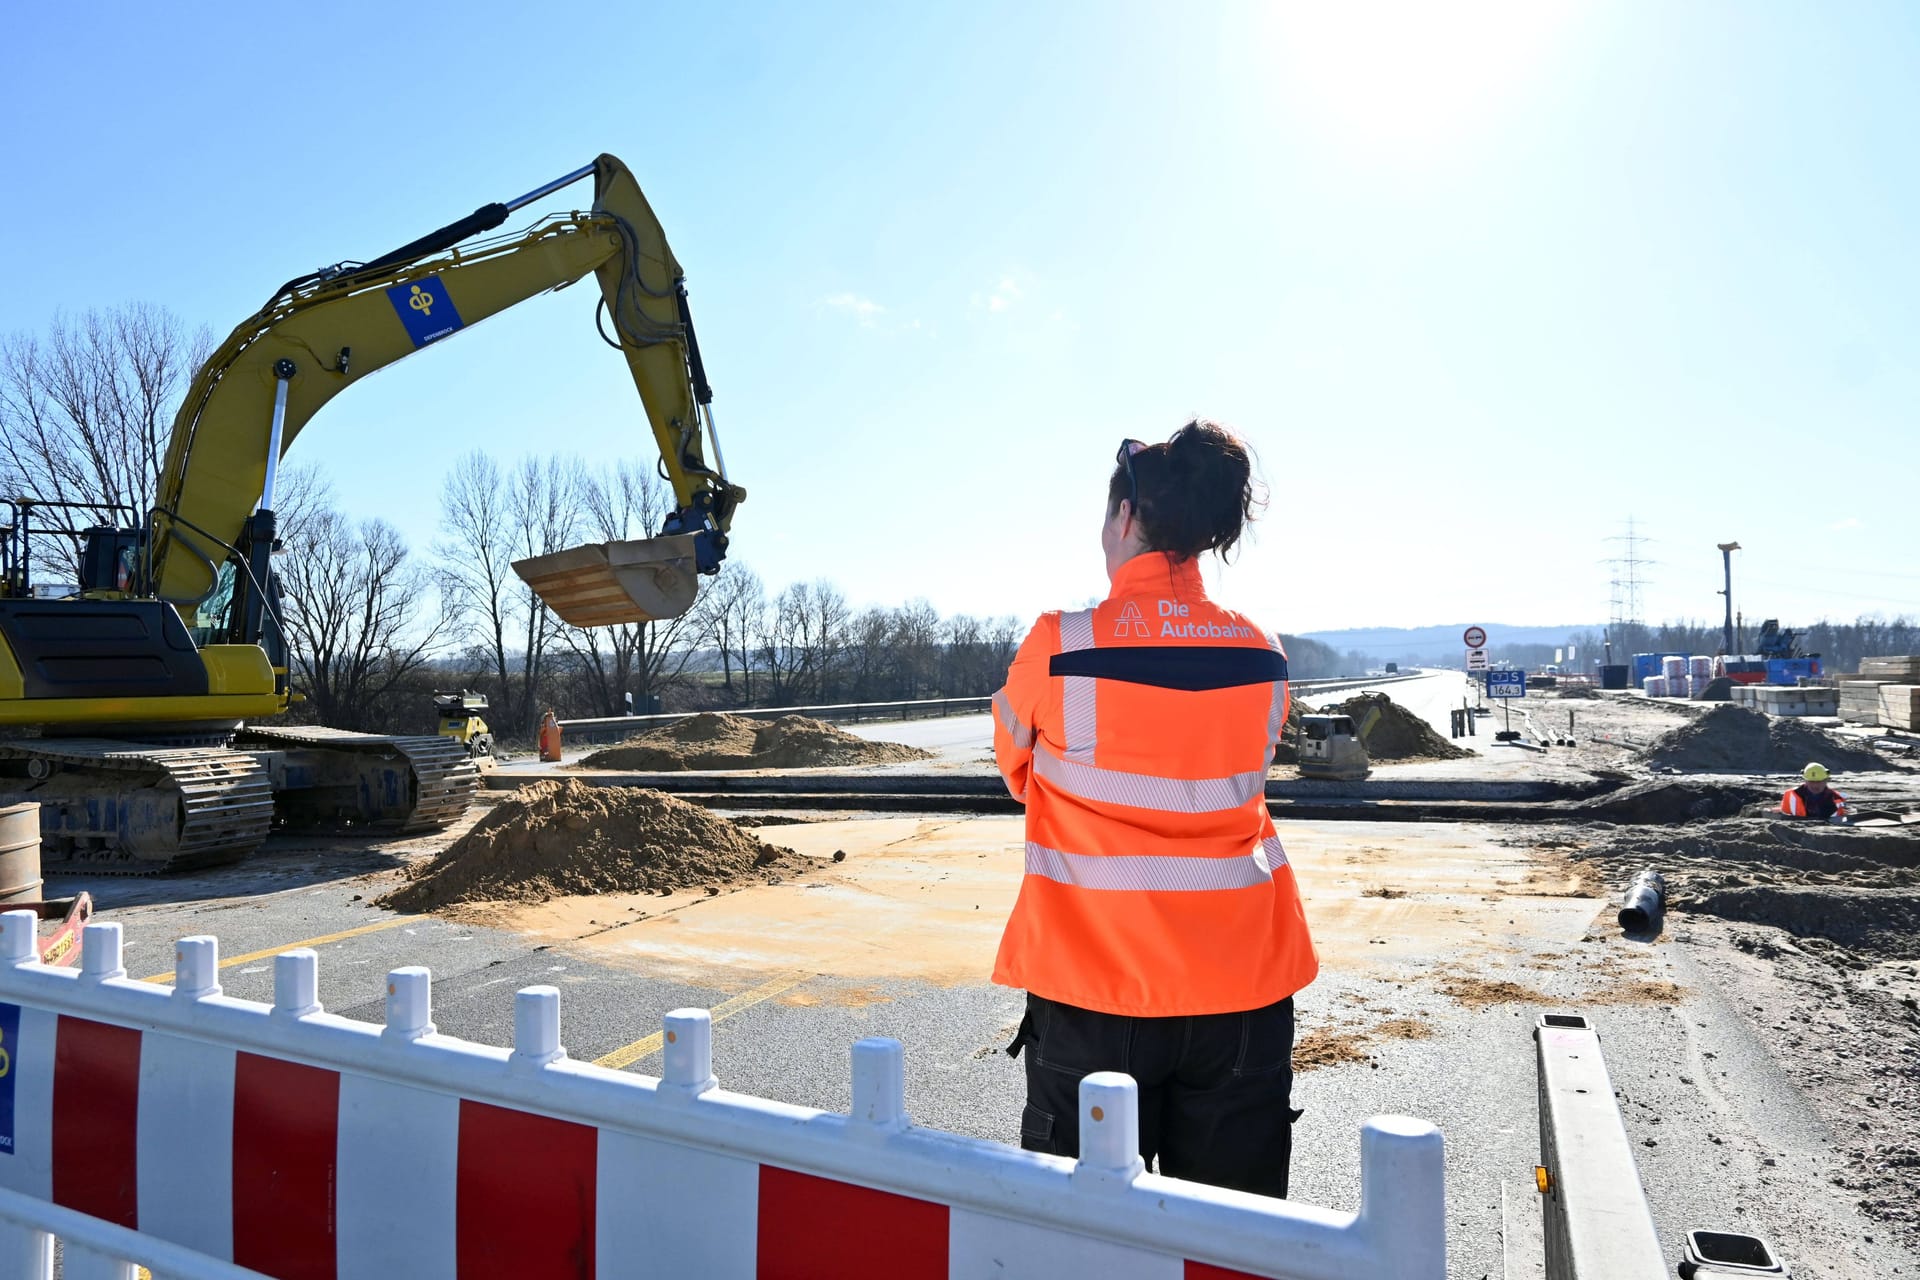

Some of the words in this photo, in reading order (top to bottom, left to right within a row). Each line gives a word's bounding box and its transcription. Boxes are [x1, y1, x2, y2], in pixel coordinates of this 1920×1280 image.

[1158, 600, 1189, 618] Die
[1160, 620, 1254, 638] Autobahn
[1511, 672, 1519, 682] S
